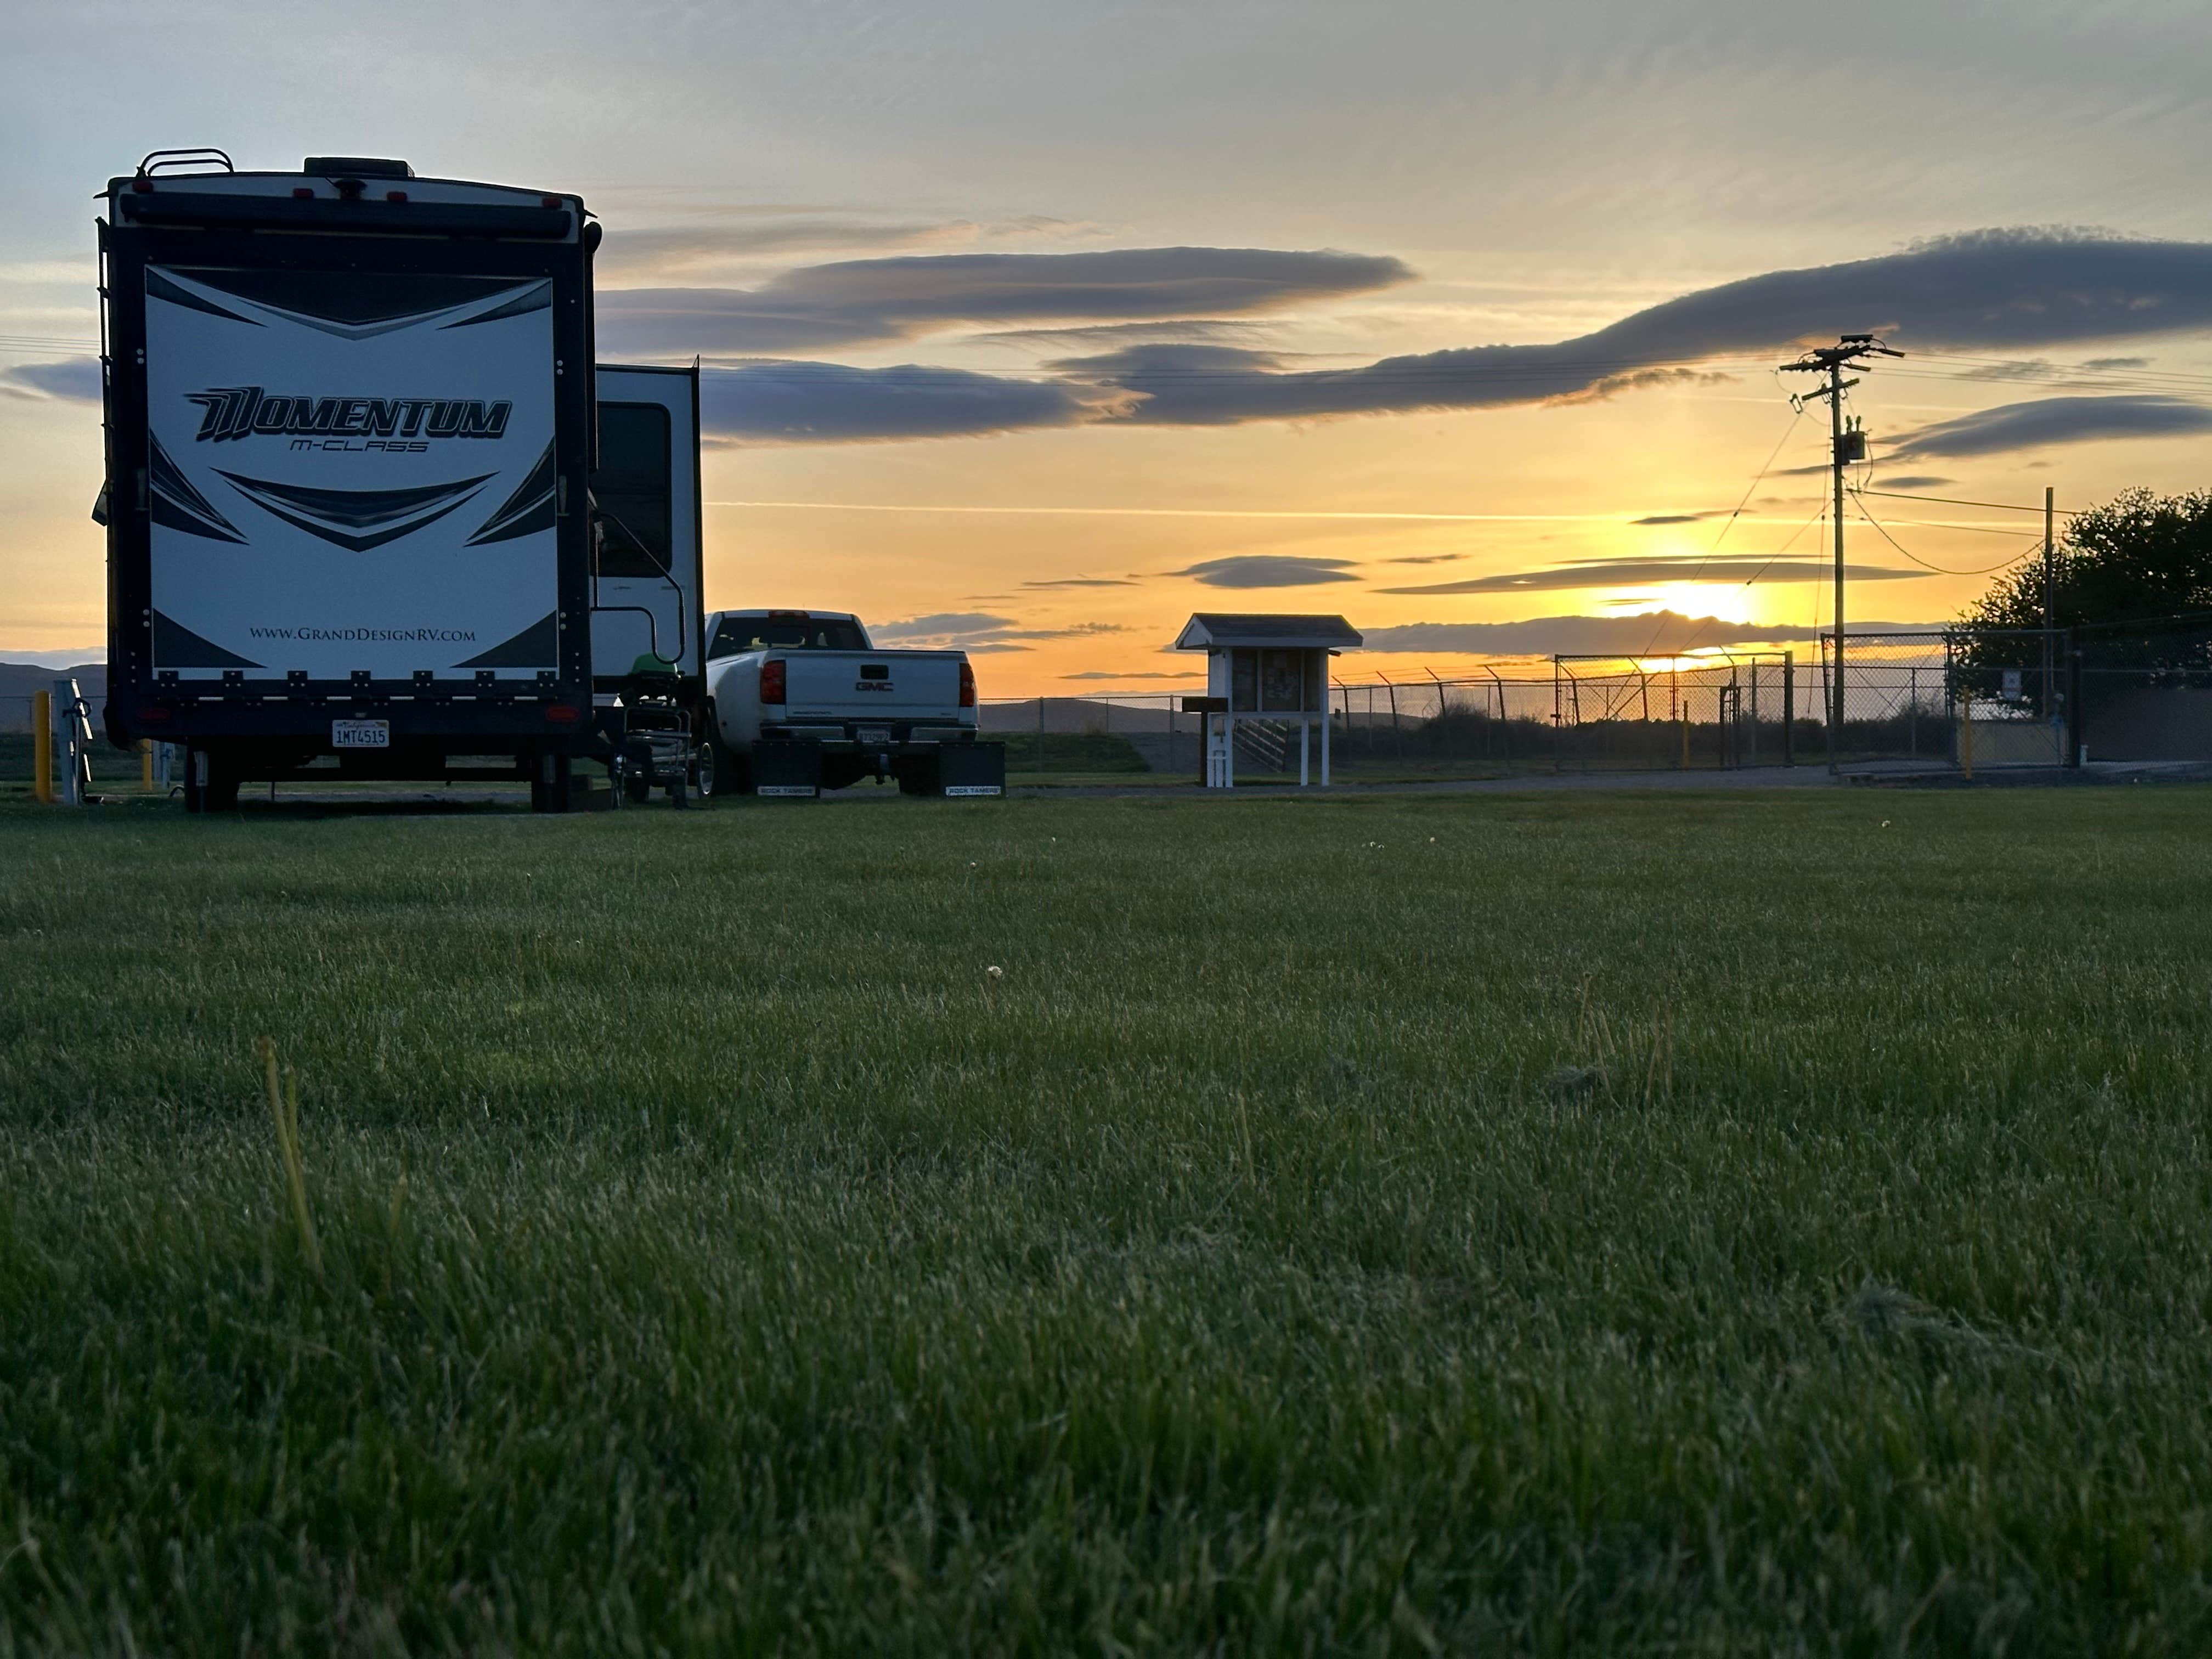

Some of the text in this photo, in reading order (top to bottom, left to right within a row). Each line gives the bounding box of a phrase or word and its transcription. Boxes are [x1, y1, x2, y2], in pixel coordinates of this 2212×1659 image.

[183, 386, 512, 442] MOMENTUM
[290, 440, 430, 452] M-CLASS
[856, 682, 894, 691] GMC
[336, 730, 386, 743] 1MT4515
